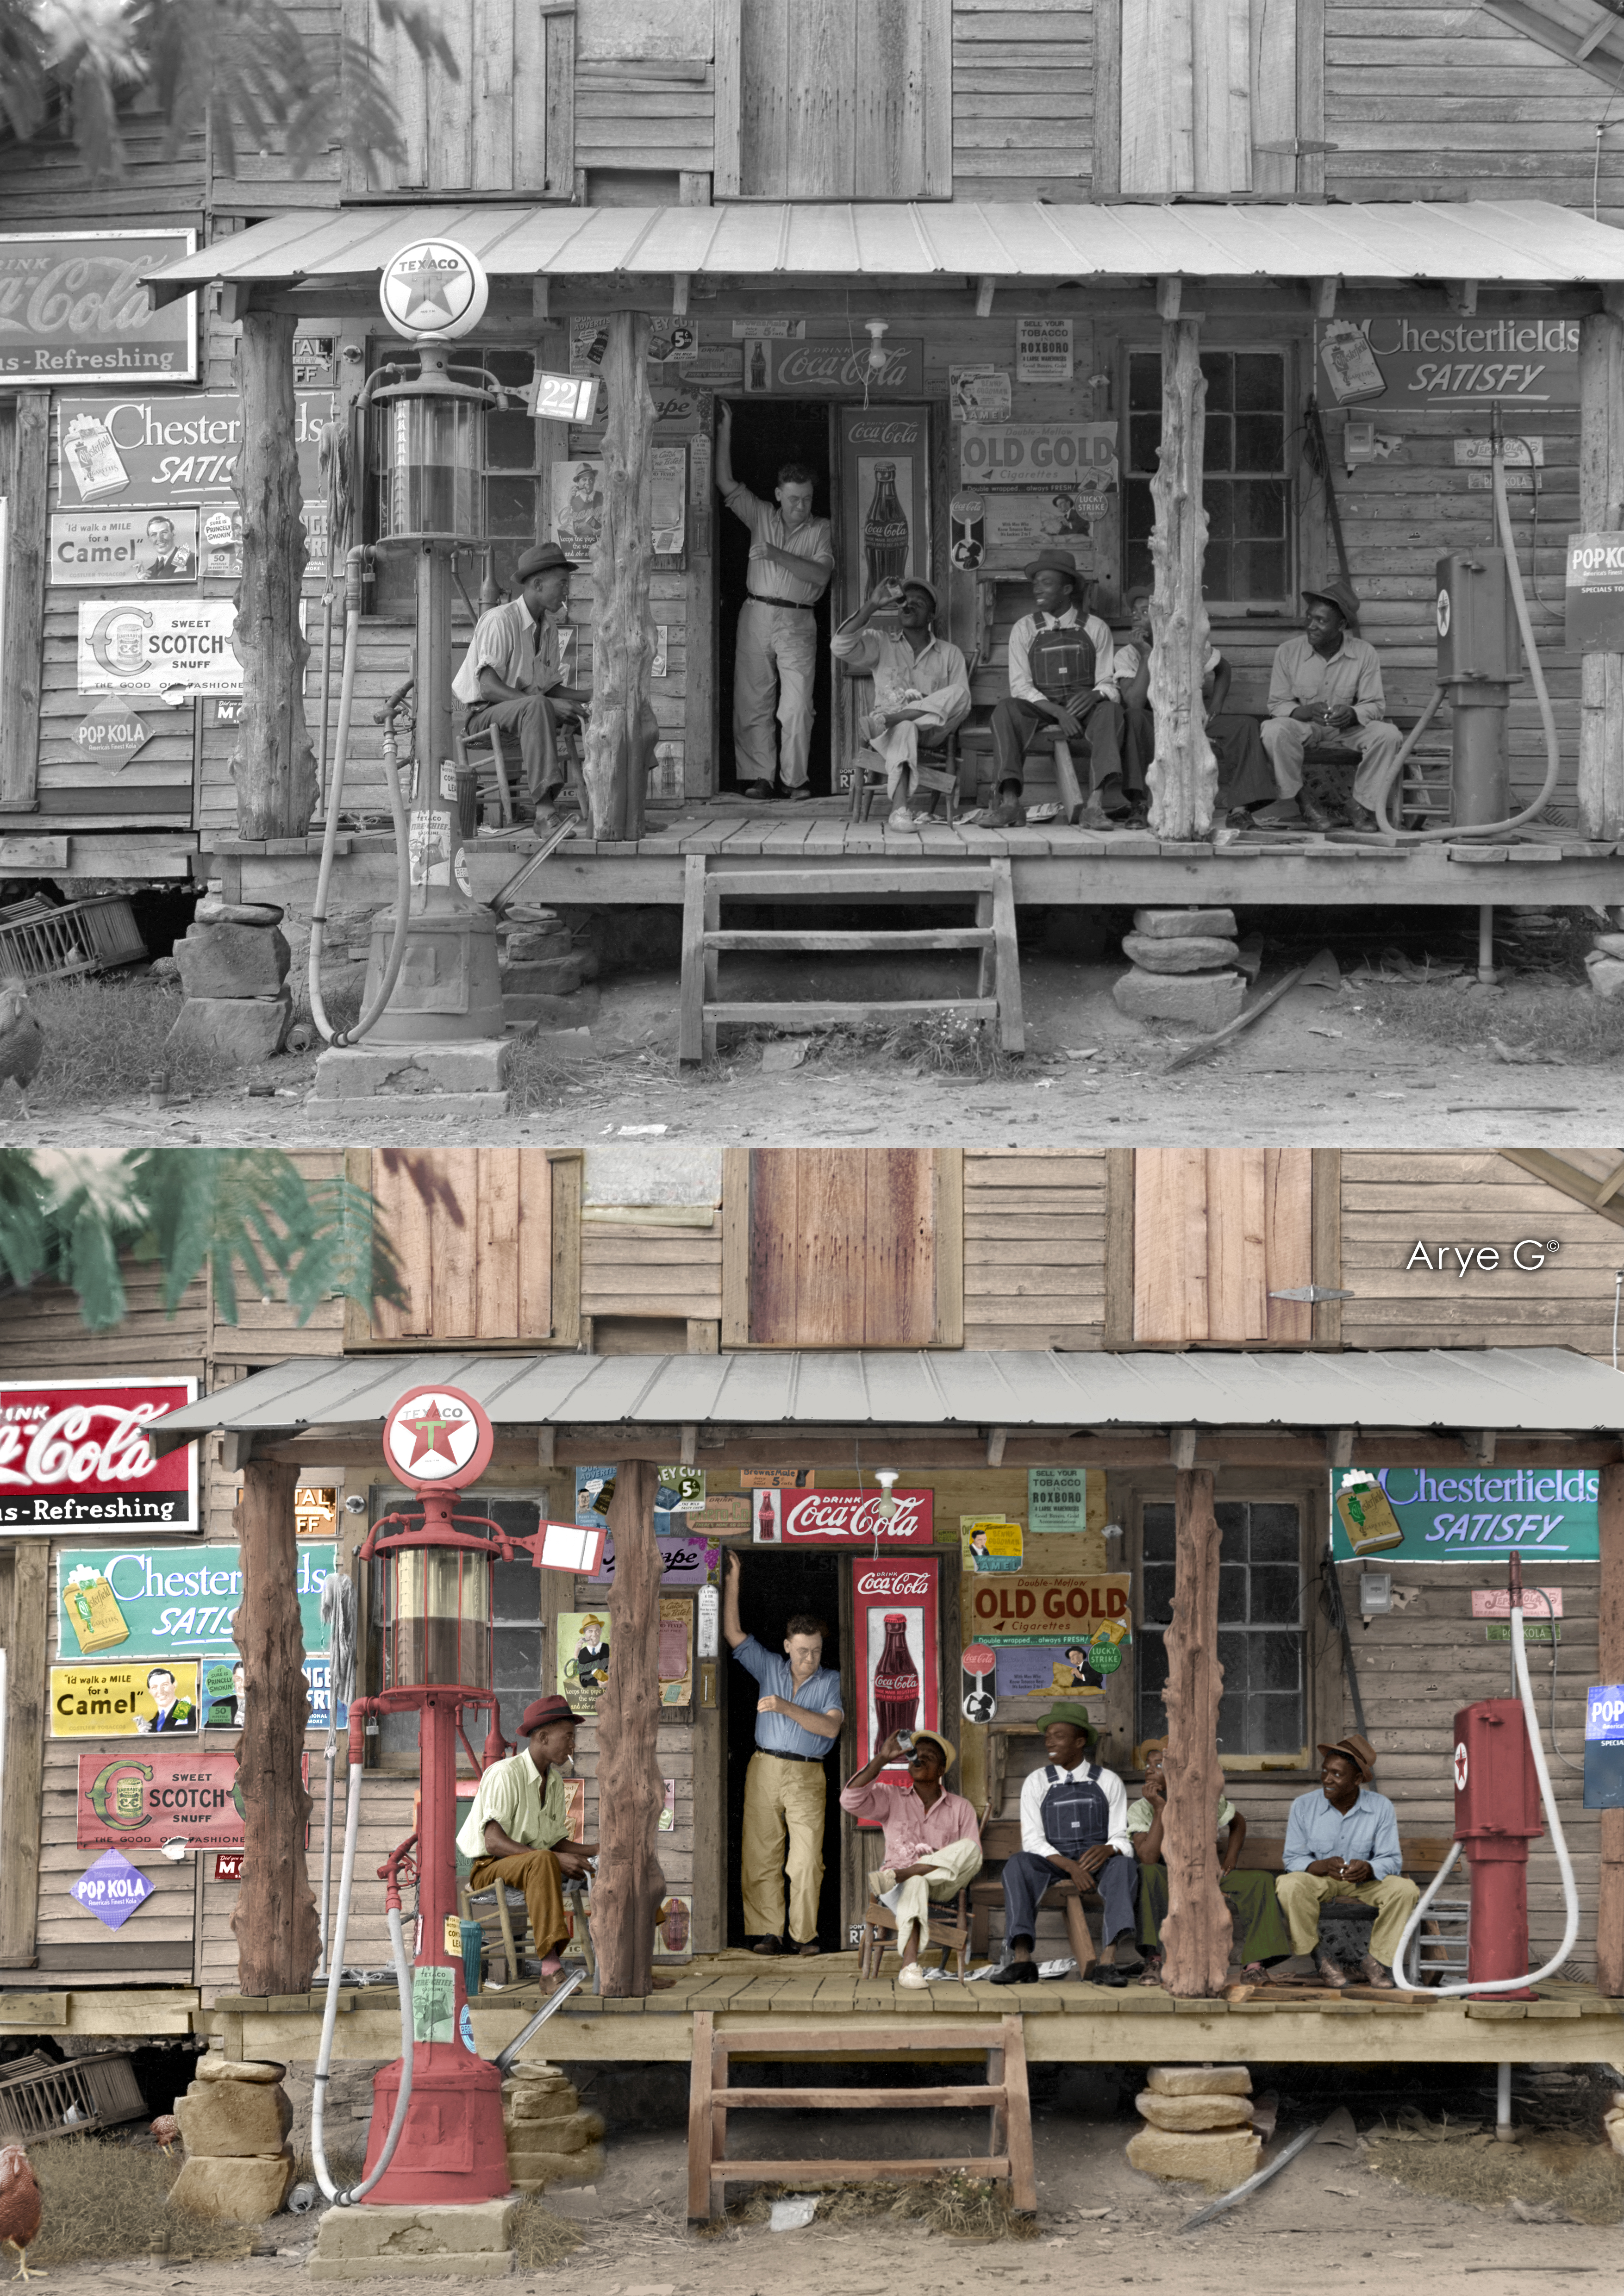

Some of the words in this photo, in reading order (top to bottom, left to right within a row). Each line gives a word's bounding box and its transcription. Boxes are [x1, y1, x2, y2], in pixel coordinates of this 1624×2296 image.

[399, 259, 459, 272] TEXACO
[675, 331, 688, 348] 5¢
[1361, 319, 1579, 356] Chesterfields
[1021, 343, 1068, 353] ROXBORO
[35, 349, 174, 370] Refreshing
[778, 347, 912, 386] Coca-Cola
[1407, 363, 1546, 392] SATISFY
[541, 380, 577, 409] 22
[104, 402, 324, 449] Chesterds
[848, 422, 919, 443] Coca-Cola
[964, 437, 1024, 467] OLD
[1031, 437, 1113, 467] GOLD
[151, 455, 237, 484] SATIS
[1000, 469, 1058, 481] Cigarettes
[1026, 485, 1049, 493] always
[952, 501, 981, 512] Coca-Cola
[80, 524, 100, 532] walk
[206, 525, 231, 533] PRINCELY
[865, 521, 907, 537] Coca-Cola
[88, 534, 101, 542] for
[1573, 548, 1605, 569] POP
[1605, 546, 1624, 568] KO
[149, 635, 223, 654] SCOTCH
[79, 725, 105, 744] POP
[107, 724, 144, 742] KOLA
[403, 1407, 463, 1421] TEXACO
[682, 1481, 696, 1497] 5¢
[1377, 1469, 1599, 1505] Chesterfields
[1033, 1492, 1081, 1503] ROXBORO
[34, 1499, 175, 1521] Refreshing
[787, 1497, 923, 1536] Coca-Cola
[1424, 1513, 1565, 1542] SATISFY
[104, 1553, 326, 1601] Chesterds
[858, 1572, 930, 1595] Coca-Cola
[975, 1588, 1036, 1618] OLD
[1043, 1588, 1127, 1618] GOLD
[1012, 1621, 1071, 1633] Cigarettes
[963, 1653, 993, 1664] Coca-Cola
[87, 1686, 101, 1695] for
[207, 1677, 232, 1685] PRINCELY
[875, 1673, 918, 1689] Coca-Cola
[1592, 1701, 1624, 1722] POP
[149, 1789, 224, 1808] SCOTCH
[78, 1880, 105, 1899] POP
[107, 1878, 145, 1897] KOLA
